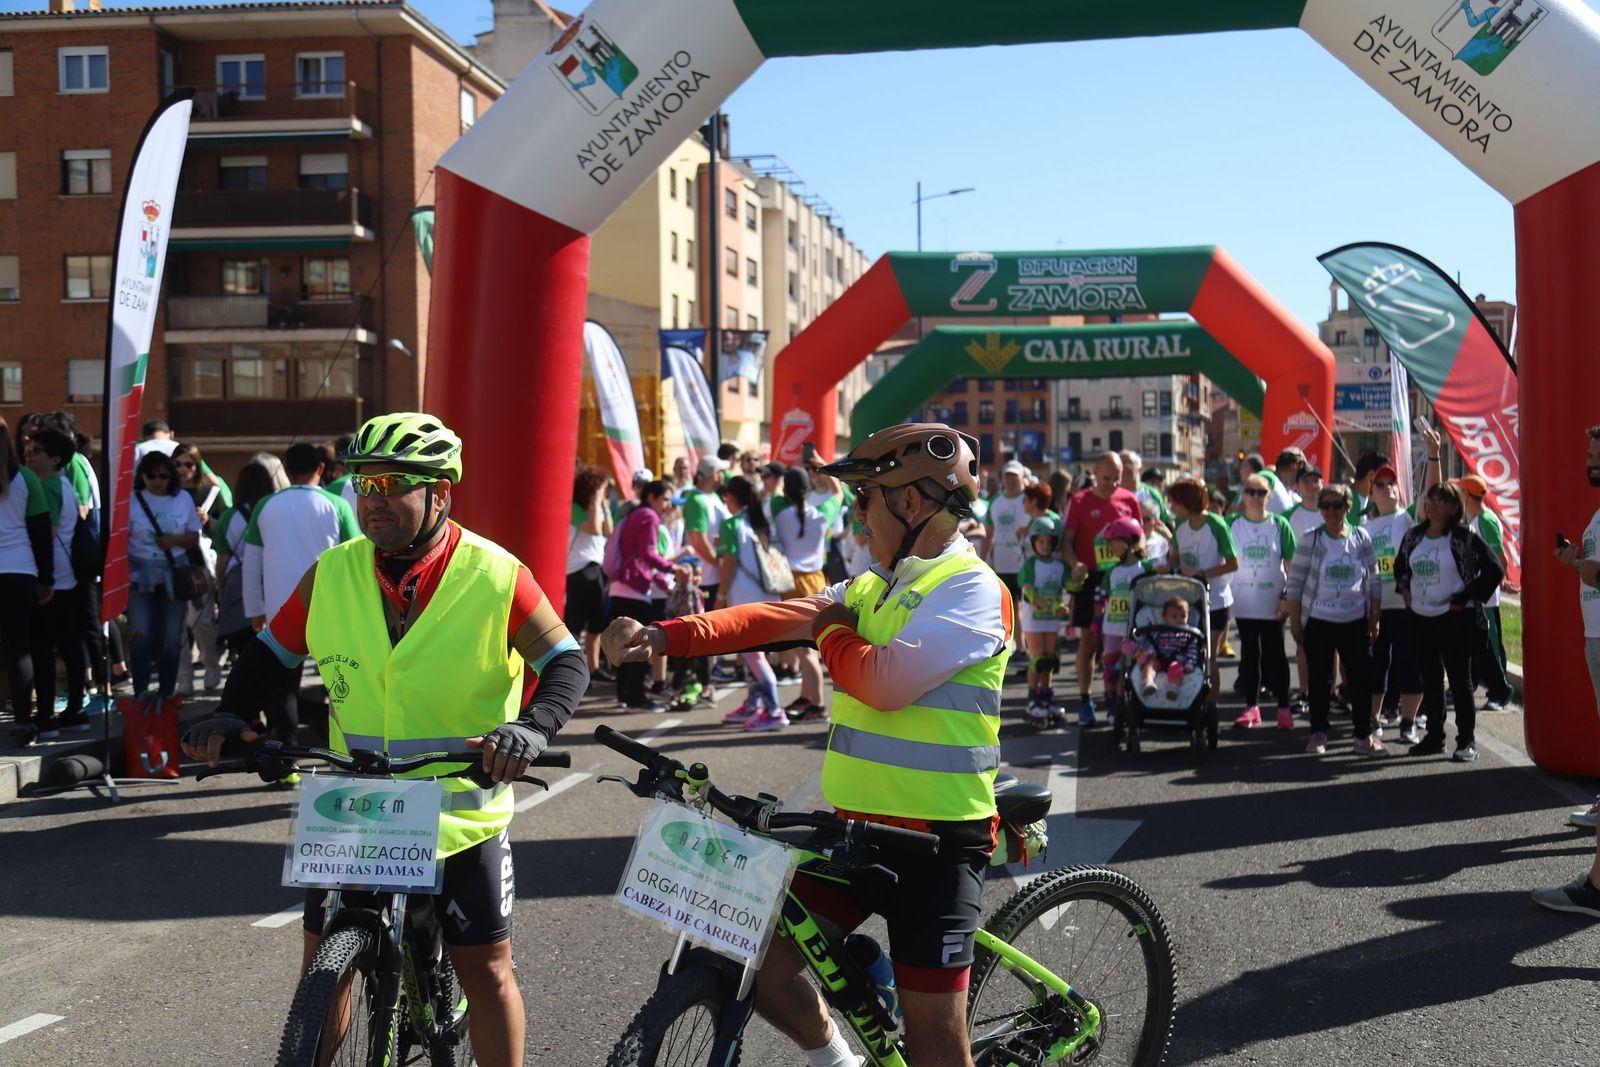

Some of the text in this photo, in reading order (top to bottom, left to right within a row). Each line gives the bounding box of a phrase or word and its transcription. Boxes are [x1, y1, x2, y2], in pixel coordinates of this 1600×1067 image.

[1353, 29, 1491, 154] DE ZAMORA
[1369, 14, 1513, 133] AYUNTAMIENTO
[576, 50, 691, 170] AYUNTAMIENTO
[588, 70, 711, 186] DE ZAMORA
[1007, 284, 1148, 312] ZAMORA
[1024, 334, 1191, 364] CAJA RURAL
[300, 842, 433, 862] ORGANIZACIÓN
[301, 862, 424, 877] PRIMERAS DAMAS
[623, 886, 759, 955] CABEZA DE CARRERA
[637, 867, 763, 932] ORGANIZACIÓN
